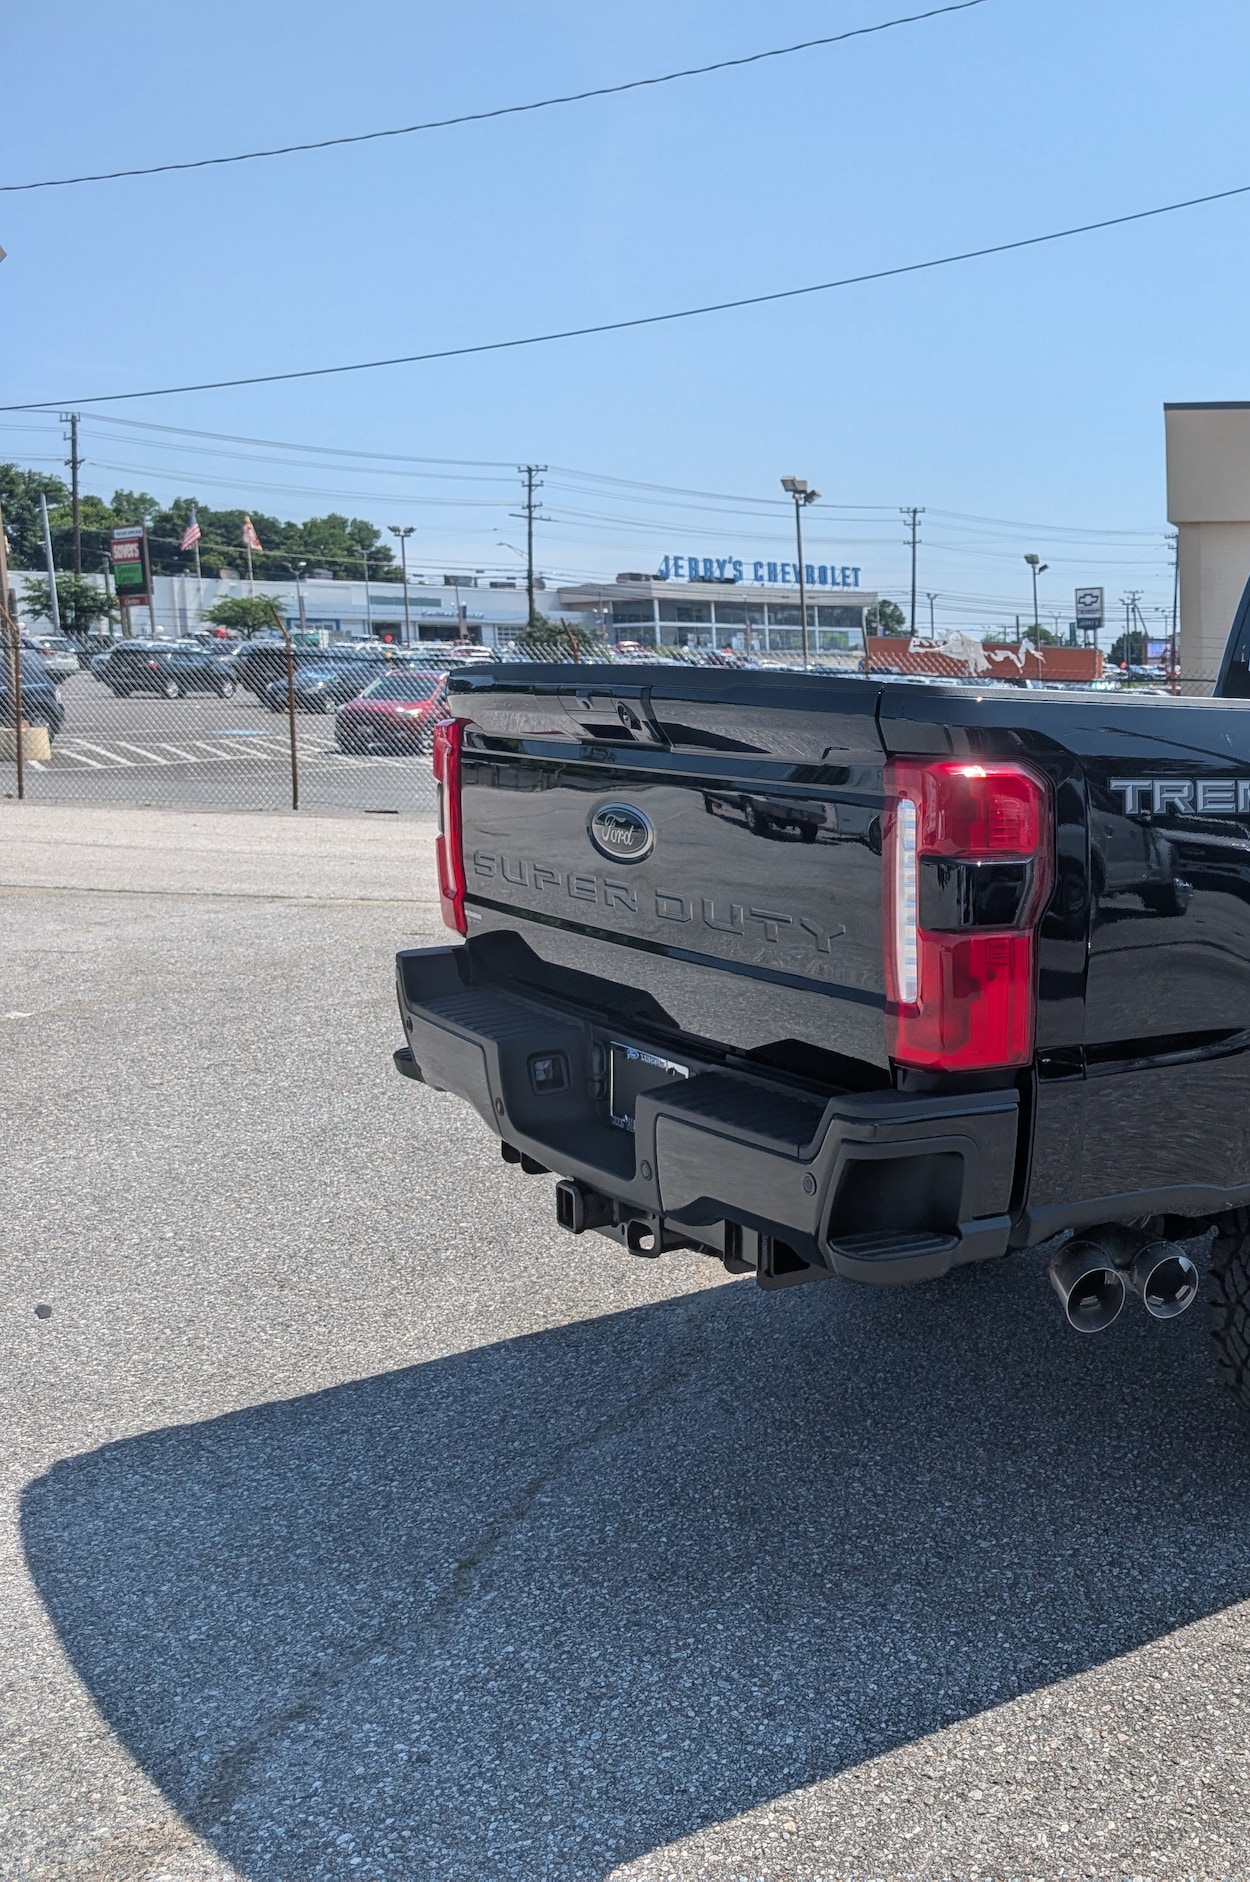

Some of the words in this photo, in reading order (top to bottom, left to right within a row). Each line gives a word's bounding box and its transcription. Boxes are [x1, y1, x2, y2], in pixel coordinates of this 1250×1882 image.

[658, 555, 743, 581] JERRY'S
[753, 561, 861, 587] CHEVROLET
[601, 814, 634, 847] Ford
[474, 851, 638, 912] SUPER
[655, 889, 847, 953] DUTY
